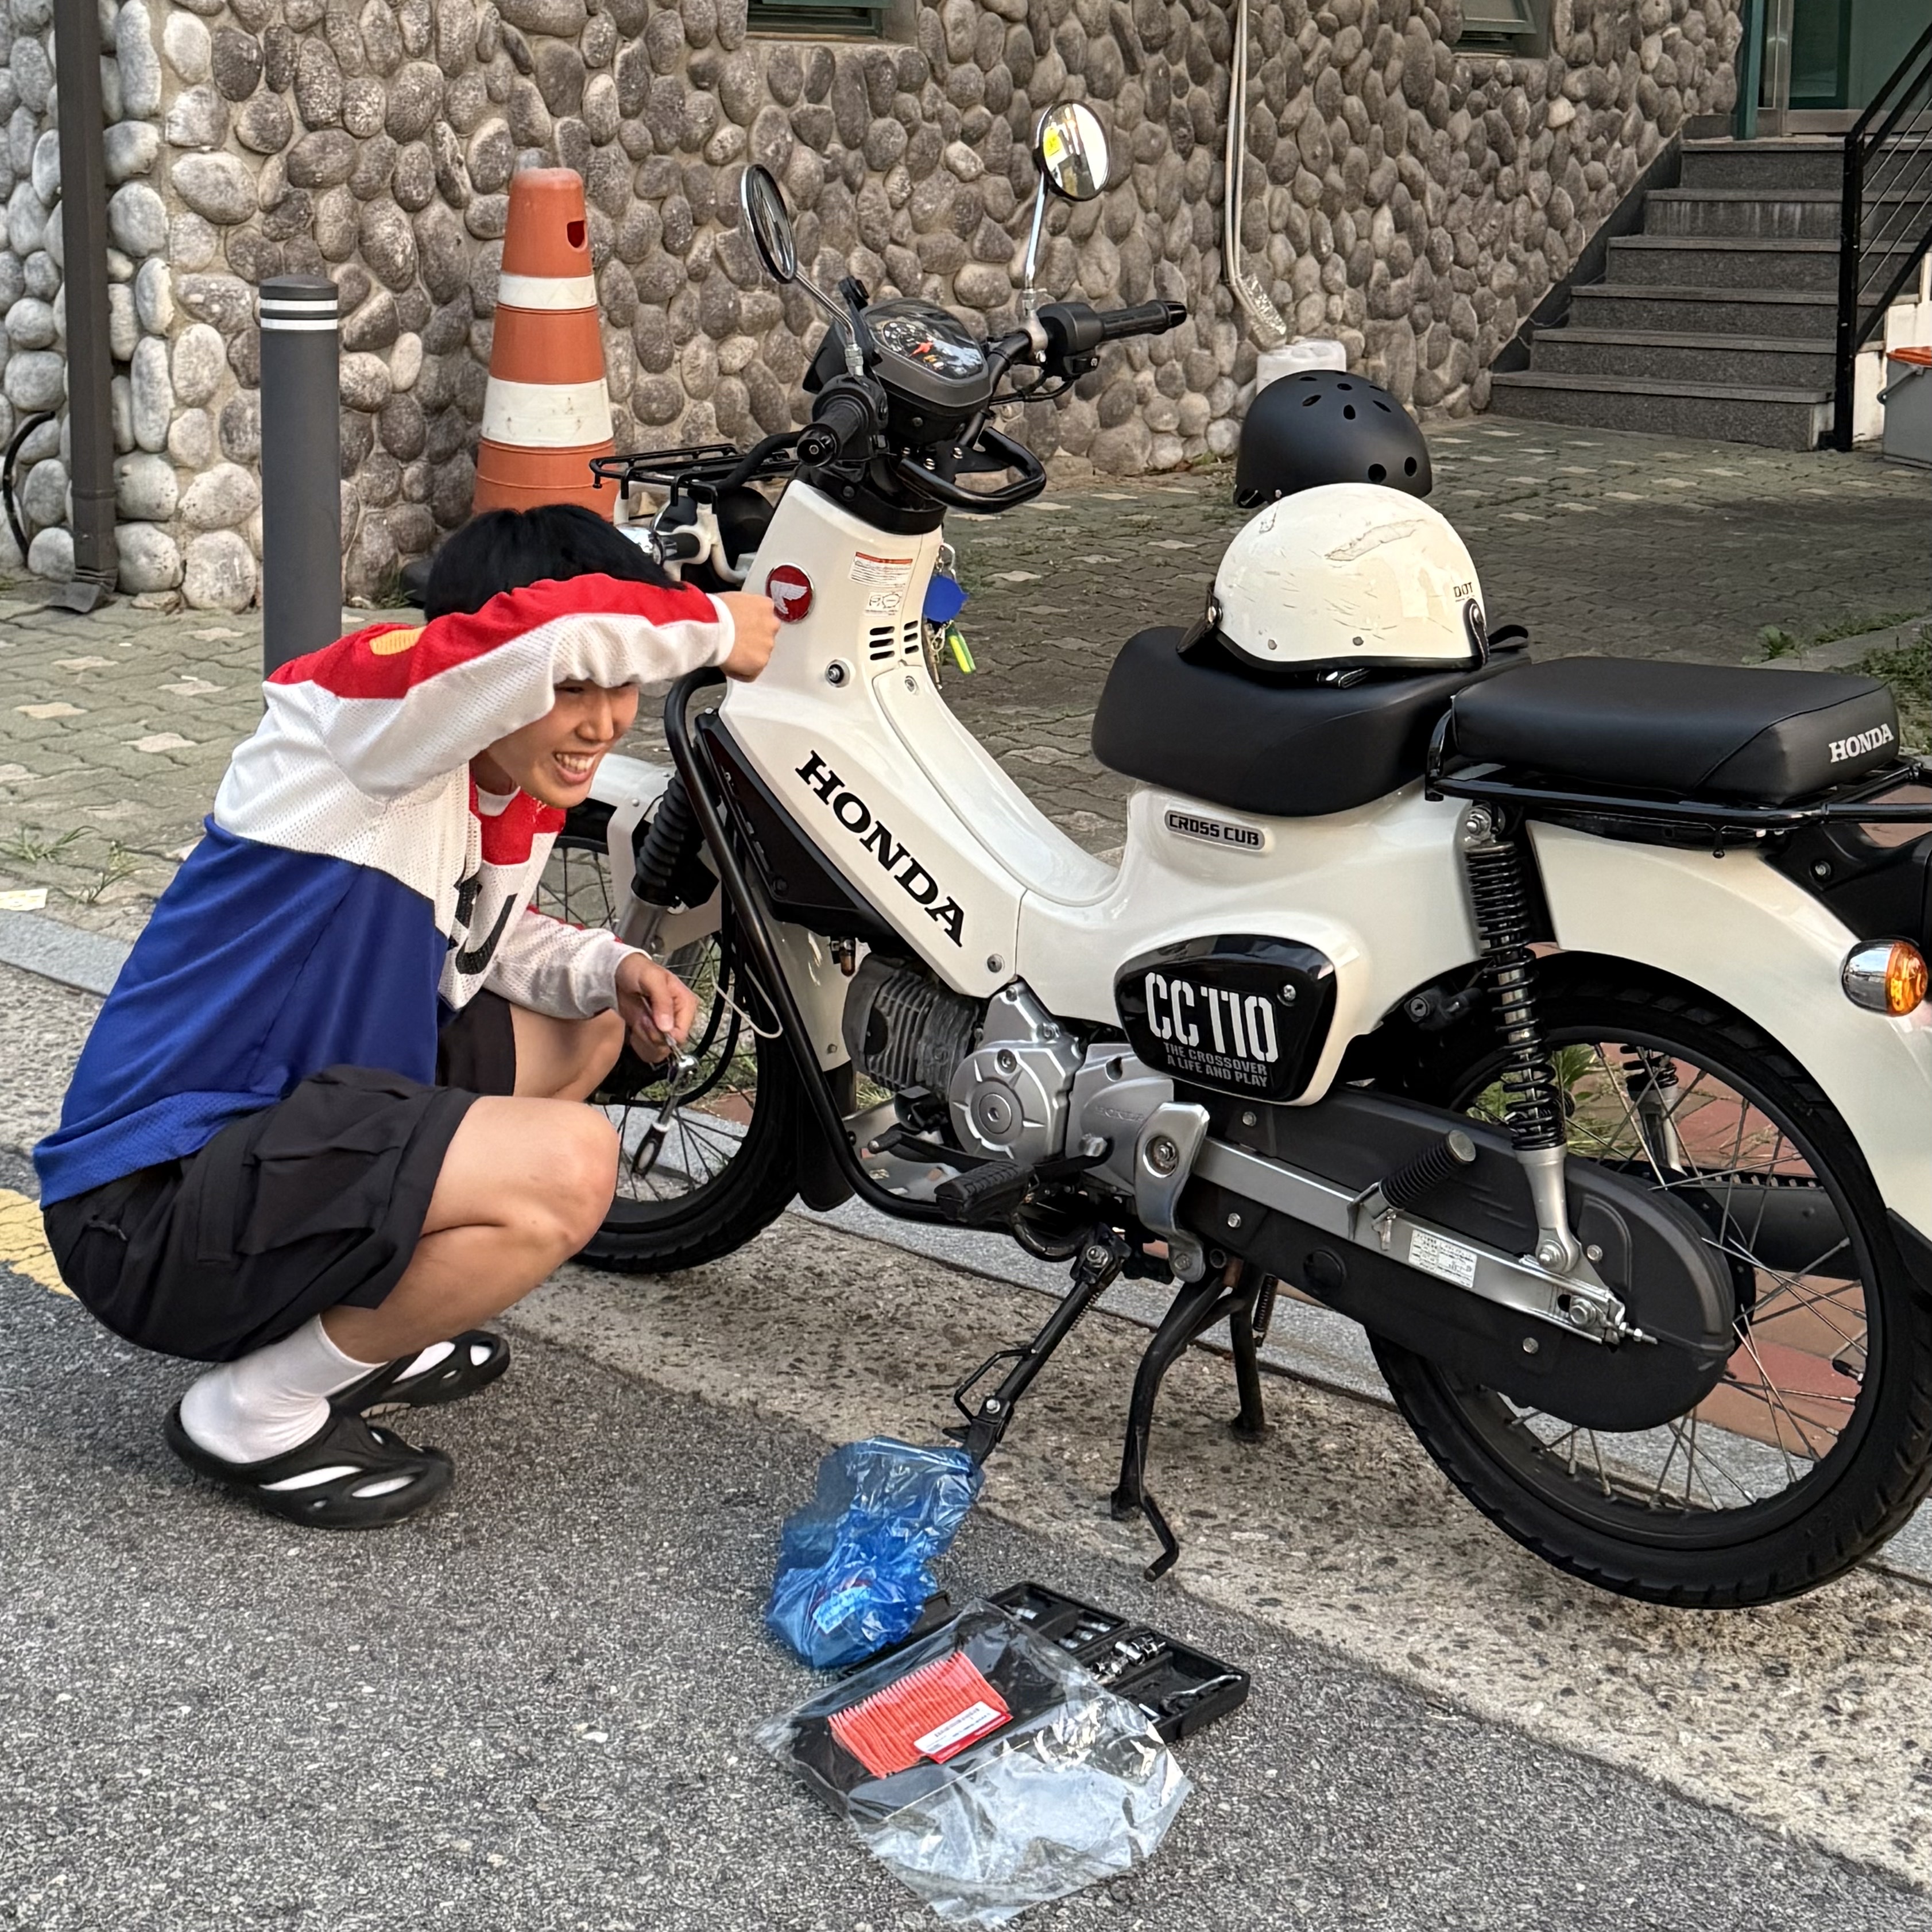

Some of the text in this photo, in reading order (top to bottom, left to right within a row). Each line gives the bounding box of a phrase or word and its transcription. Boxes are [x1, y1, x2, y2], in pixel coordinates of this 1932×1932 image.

[1453, 582, 1473, 597] DOT
[1829, 723, 1894, 763] HONDA
[1170, 814, 1259, 845] CROSS CUB
[795, 750, 965, 947] HONDA
[1164, 1042, 1267, 1075] THE CROSSOVER
[1168, 1055, 1267, 1087] A LIFE AND PLAY
